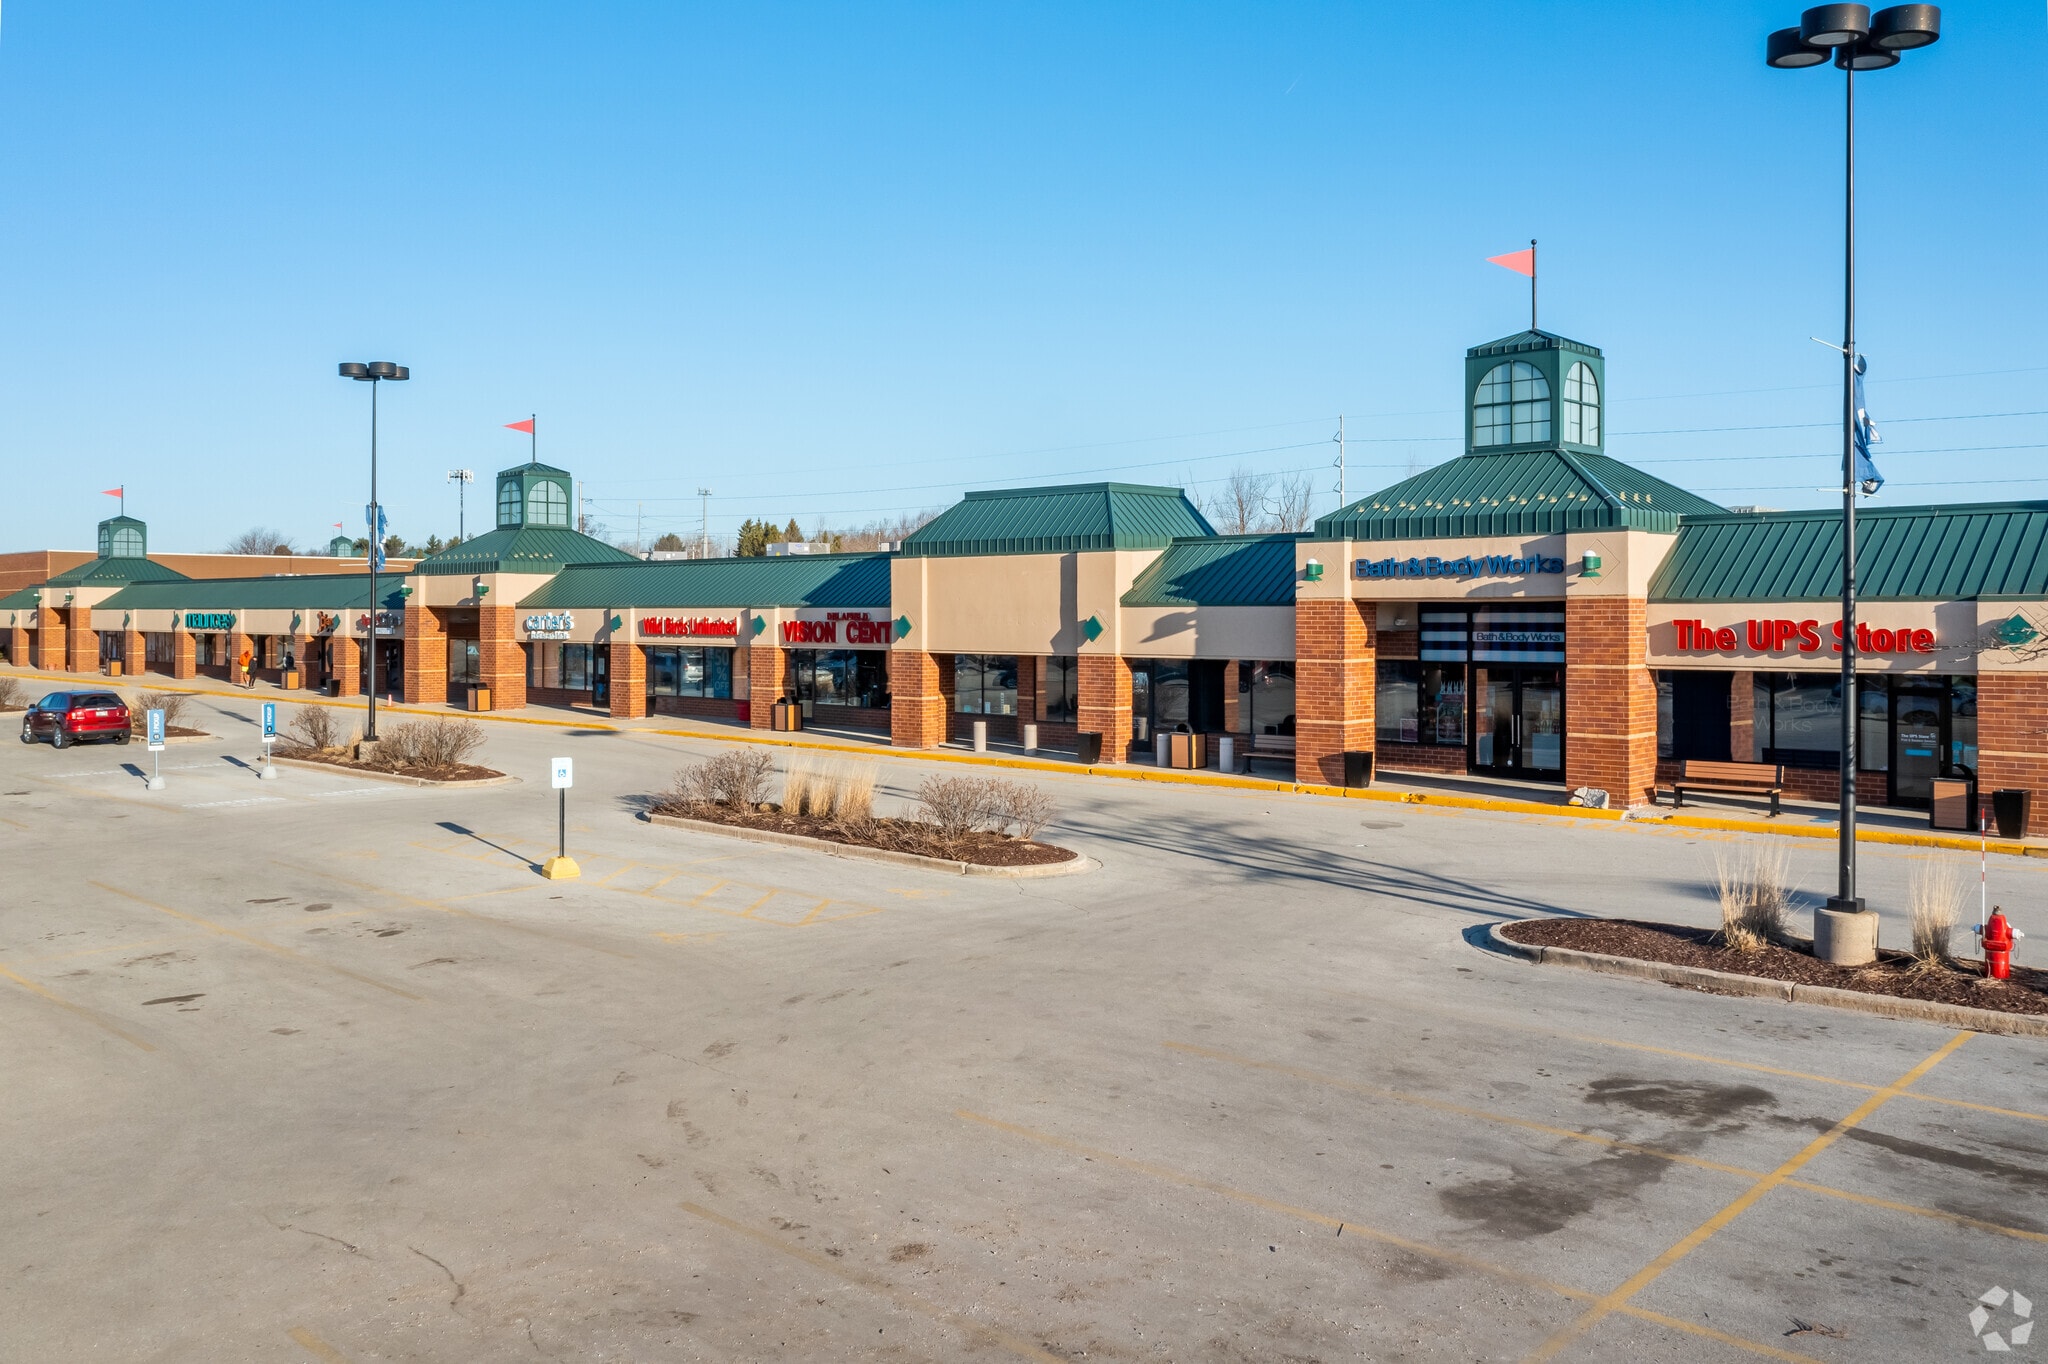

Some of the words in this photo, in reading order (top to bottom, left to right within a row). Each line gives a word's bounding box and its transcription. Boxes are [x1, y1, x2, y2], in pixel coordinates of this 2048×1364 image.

[1355, 557, 1405, 577] Bath
[1406, 557, 1424, 577] &
[1426, 555, 1484, 579] Body
[1485, 553, 1565, 576] Works
[526, 610, 574, 630] carter's
[643, 616, 663, 635] Wild
[665, 616, 690, 635] Birds
[690, 616, 738, 636] Unlimited
[783, 621, 837, 643] VISION
[1476, 632, 1498, 642] Bath
[1498, 633, 1506, 642] &
[1506, 632, 1530, 643] Body
[1530, 632, 1561, 642] Works
[1672, 618, 1738, 652] The
[1746, 618, 1822, 653] UPS
[714, 648, 729, 666] 50
[714, 681, 730, 691] OFF
